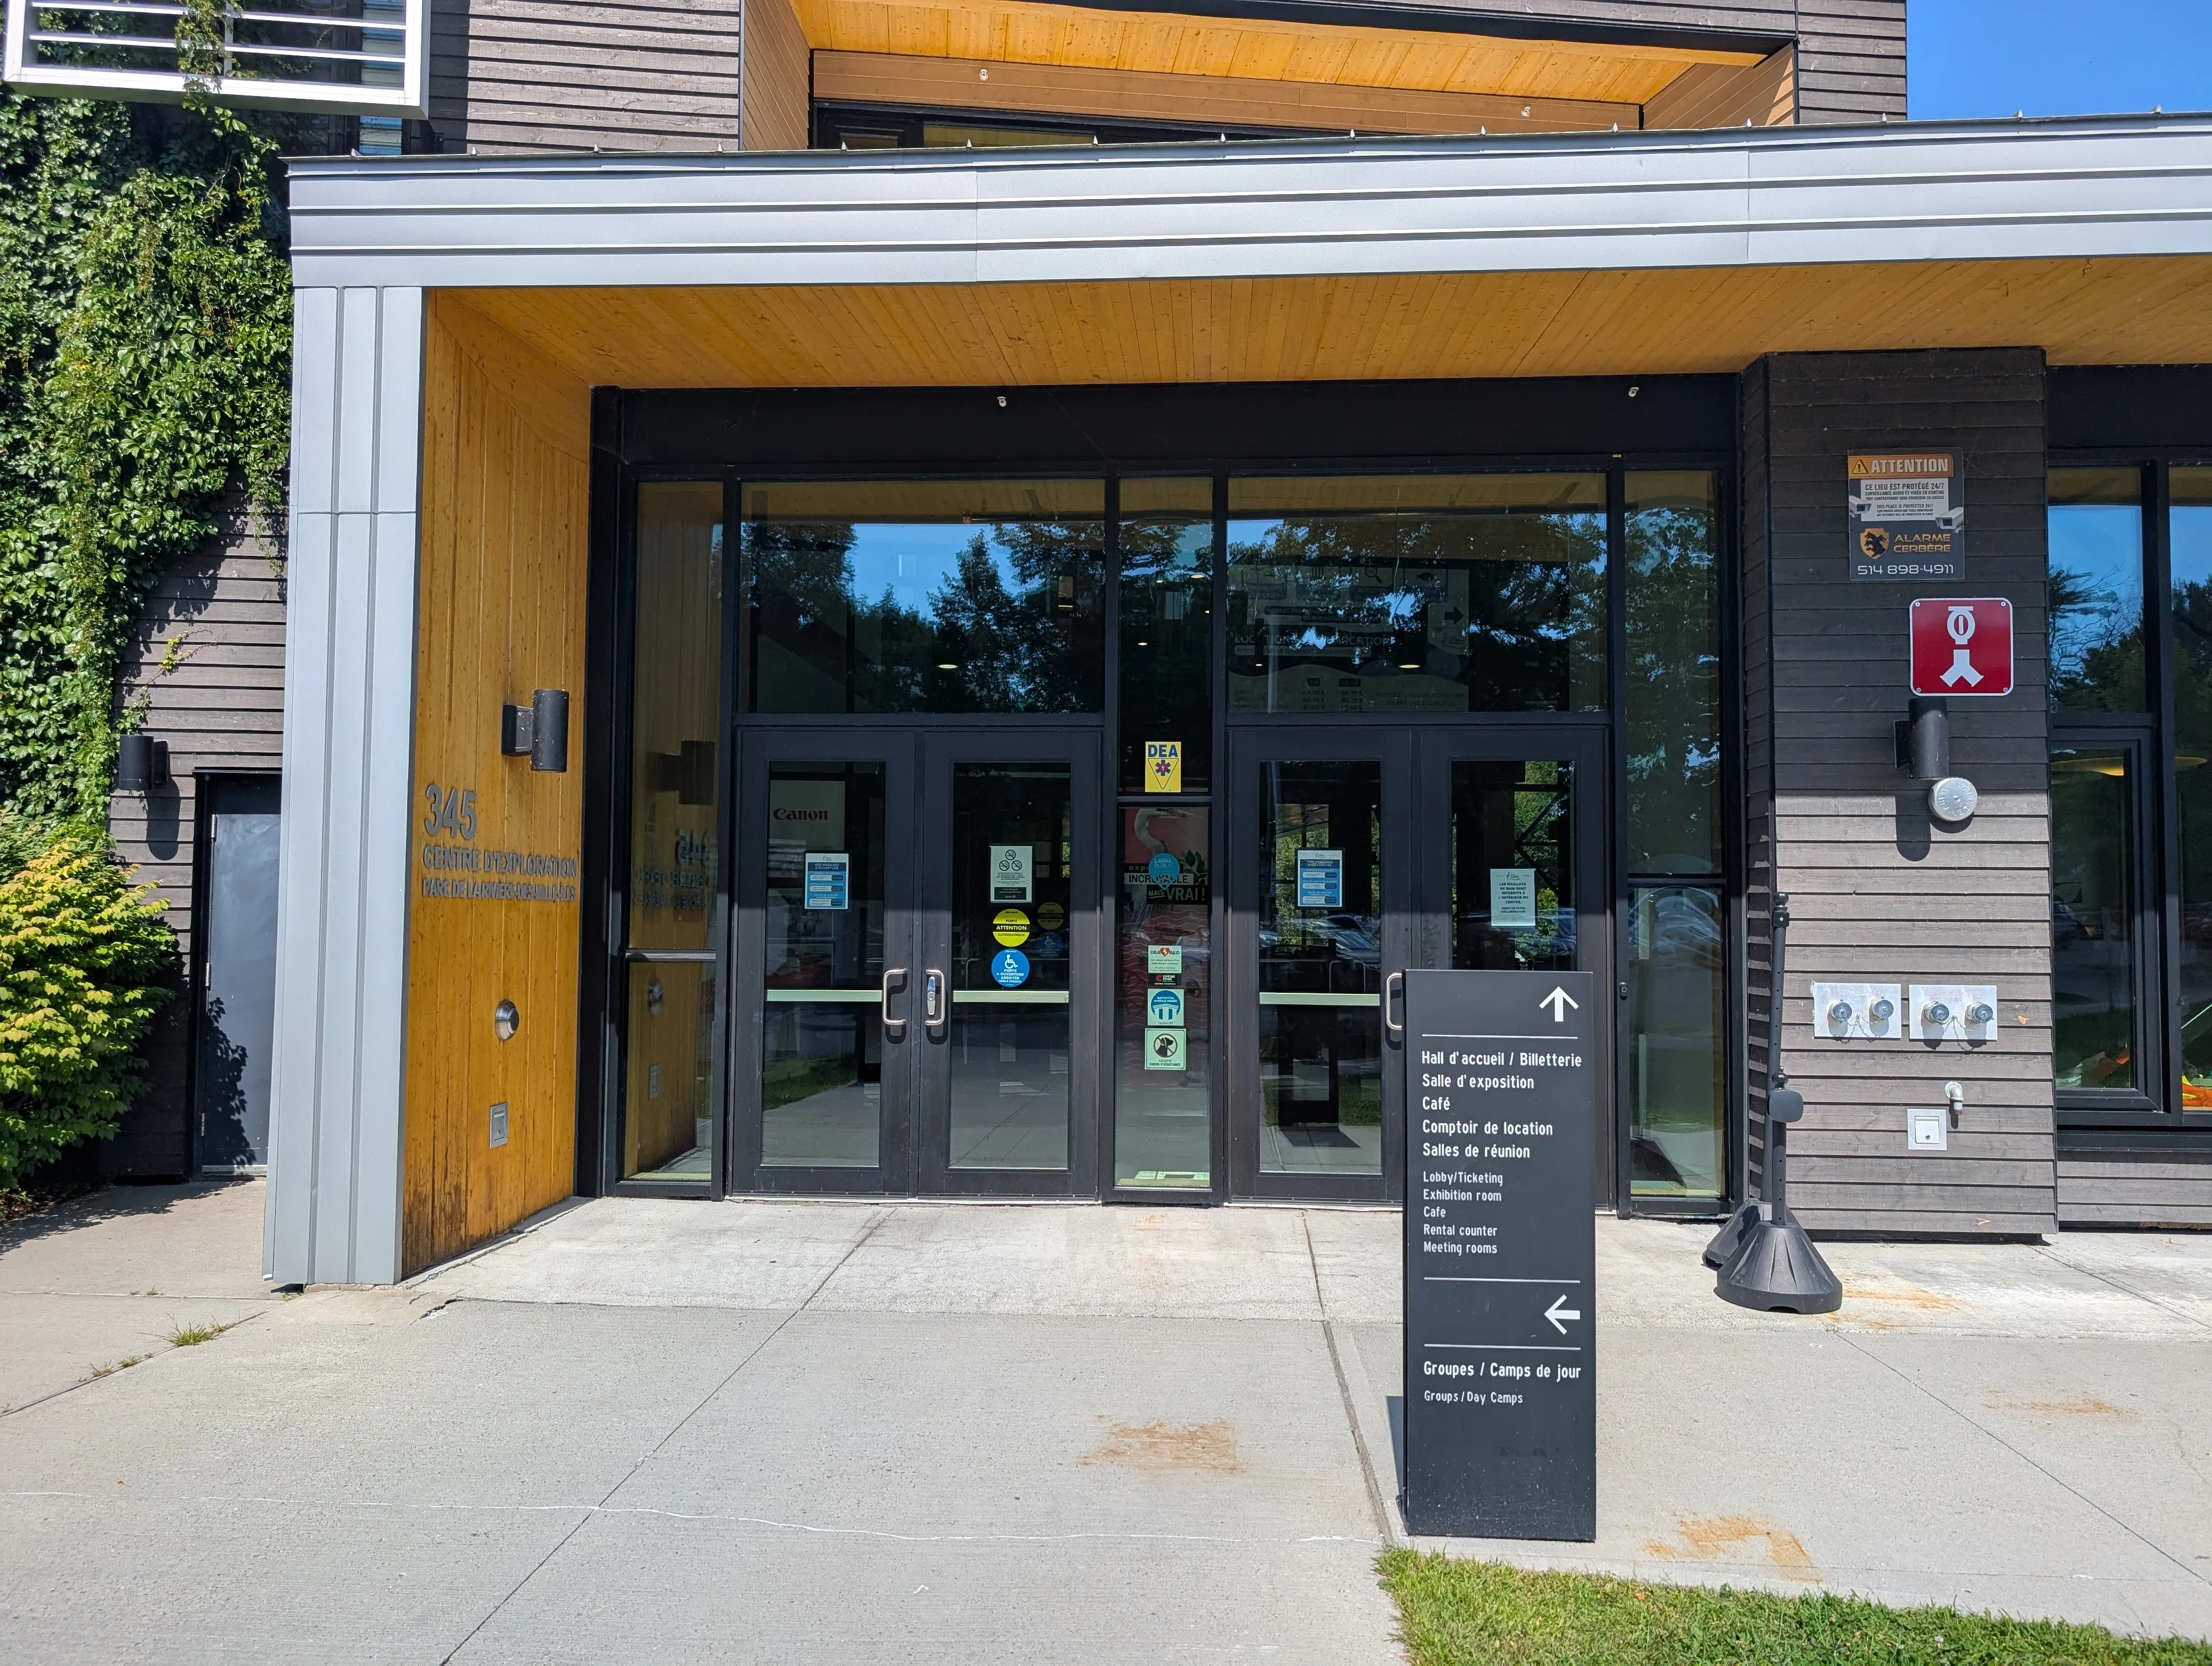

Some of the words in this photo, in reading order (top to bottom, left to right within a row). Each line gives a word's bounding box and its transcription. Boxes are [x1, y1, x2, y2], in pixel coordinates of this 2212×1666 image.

[1871, 458, 1949, 474] ATTENTION
[1902, 482, 1930, 490] PROTÉGÉ
[1894, 534, 1951, 543] ALARME
[1893, 543, 1951, 553] CERBÈRE
[1857, 565, 1883, 575] 514
[1887, 564, 1954, 575] 898-4911
[1148, 744, 1179, 758] DEA
[423, 784, 478, 840] 345
[773, 808, 828, 821] Canon
[423, 845, 482, 873] CENTRE
[484, 850, 577, 878] D'EXPLORATION
[422, 878, 451, 898] PARC
[1421, 1050, 1444, 1065] Hall
[1449, 1051, 1505, 1066] d'accueil
[1509, 1052, 1514, 1066] /
[1520, 1052, 1583, 1067] Billetterie
[1422, 1073, 1452, 1088] Salle
[1456, 1074, 1535, 1091] d'exposition
[1422, 1095, 1450, 1111] Café
[1422, 1119, 1478, 1137] Comptoir
[1483, 1121, 1499, 1135] de
[1503, 1121, 1554, 1136] location
[1422, 1142, 1459, 1157] Salles
[1464, 1144, 1480, 1157] de
[1484, 1144, 1531, 1158] réunion
[1423, 1171, 1503, 1187] Lobby/Ticketing
[1423, 1188, 1472, 1201] Exhibition
[1476, 1191, 1502, 1202] room
[1423, 1206, 1446, 1218] Cafe
[1423, 1223, 1455, 1235] Rental
[1459, 1225, 1498, 1236] counter
[1423, 1241, 1462, 1256] Meeting
[1465, 1243, 1498, 1254] rooms
[1423, 1361, 1475, 1379] Groupes
[1480, 1362, 1486, 1376] /
[1490, 1362, 1532, 1381] Camps
[1536, 1364, 1551, 1378] de
[1555, 1364, 1581, 1383] jour
[1490, 1392, 1523, 1406] Camps
